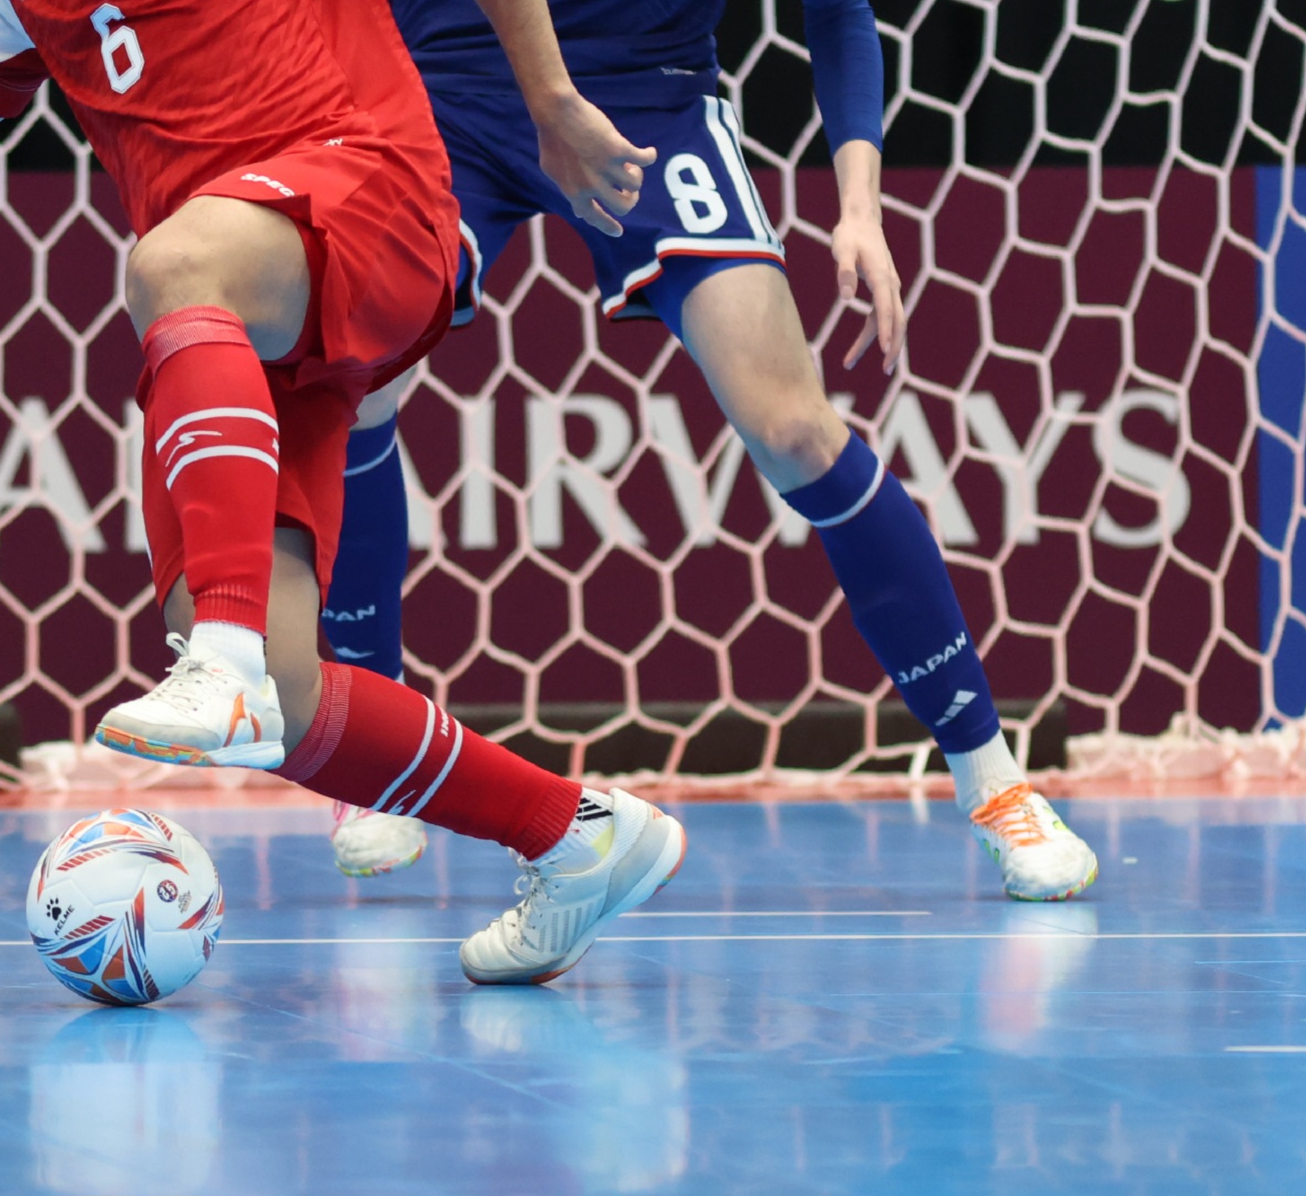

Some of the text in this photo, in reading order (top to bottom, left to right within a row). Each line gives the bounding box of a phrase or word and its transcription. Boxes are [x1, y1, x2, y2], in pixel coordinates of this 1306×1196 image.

[90, 3, 145, 94] 6
[664, 153, 728, 234] 8
[898, 631, 967, 684] JAPAN
[54, 904, 75, 936] KELME
